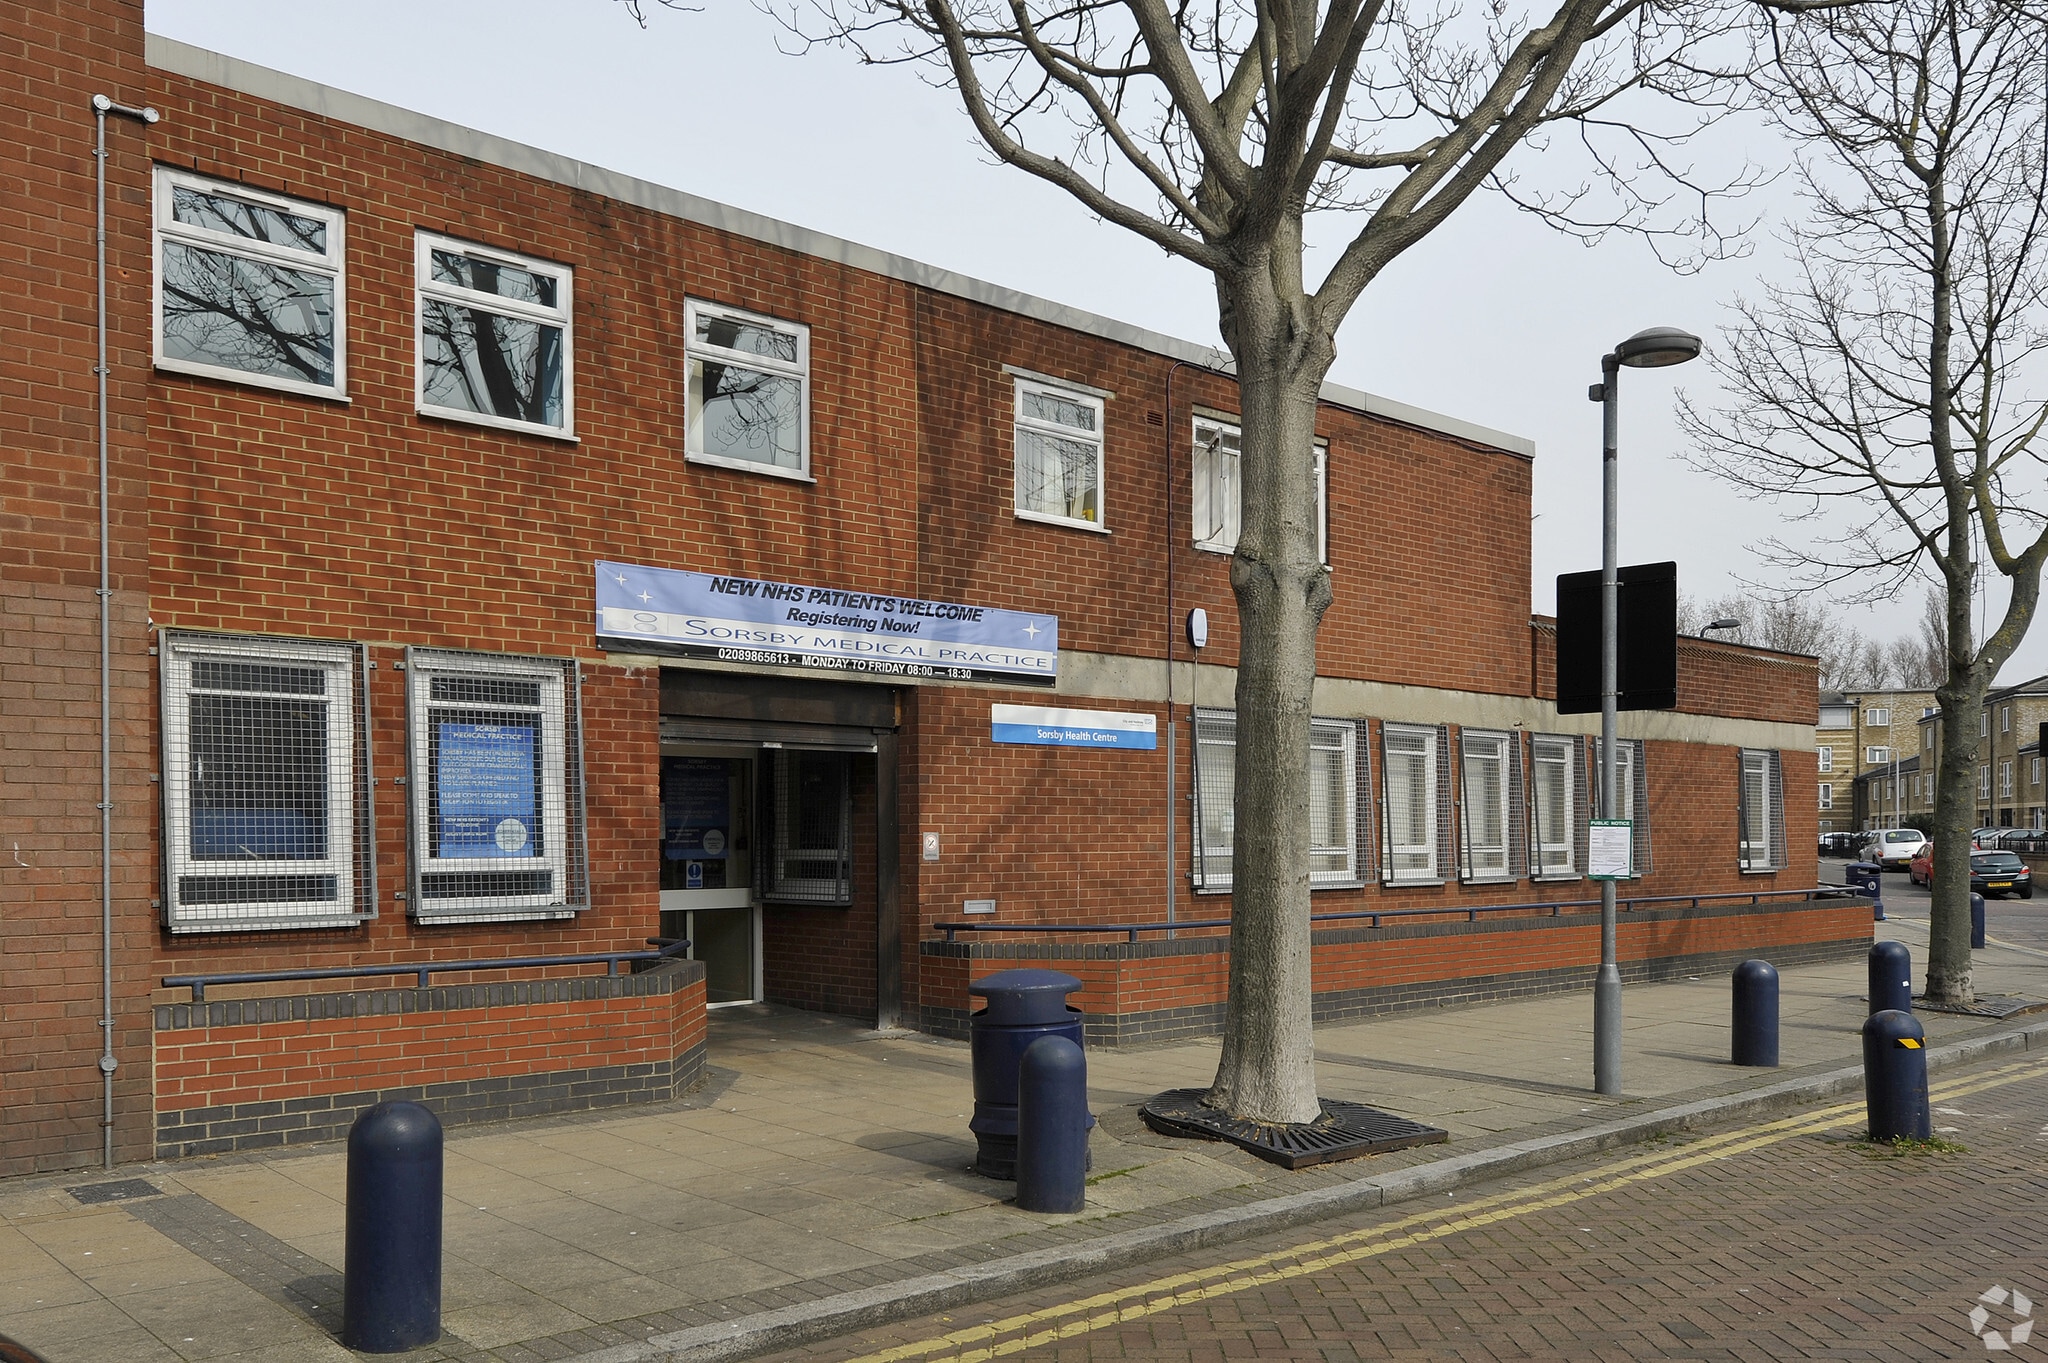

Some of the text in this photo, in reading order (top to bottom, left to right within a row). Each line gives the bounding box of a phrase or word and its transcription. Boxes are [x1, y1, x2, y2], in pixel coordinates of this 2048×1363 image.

[710, 577, 984, 623] NEW NHS PATIENTS WELCOME
[786, 607, 921, 634] Registering Now!
[685, 619, 1048, 668] SORSBY MEDICAL PRACTICE
[718, 648, 789, 664] 02089865613
[802, 655, 851, 670] MONDAY
[851, 659, 866, 671] TO
[868, 661, 906, 675] FRIDAY
[907, 664, 933, 677] 08:00
[947, 668, 972, 680] 18:30
[474, 725, 502, 733] SORSBY
[1037, 729, 1118, 743] Sorsby Health Centre
